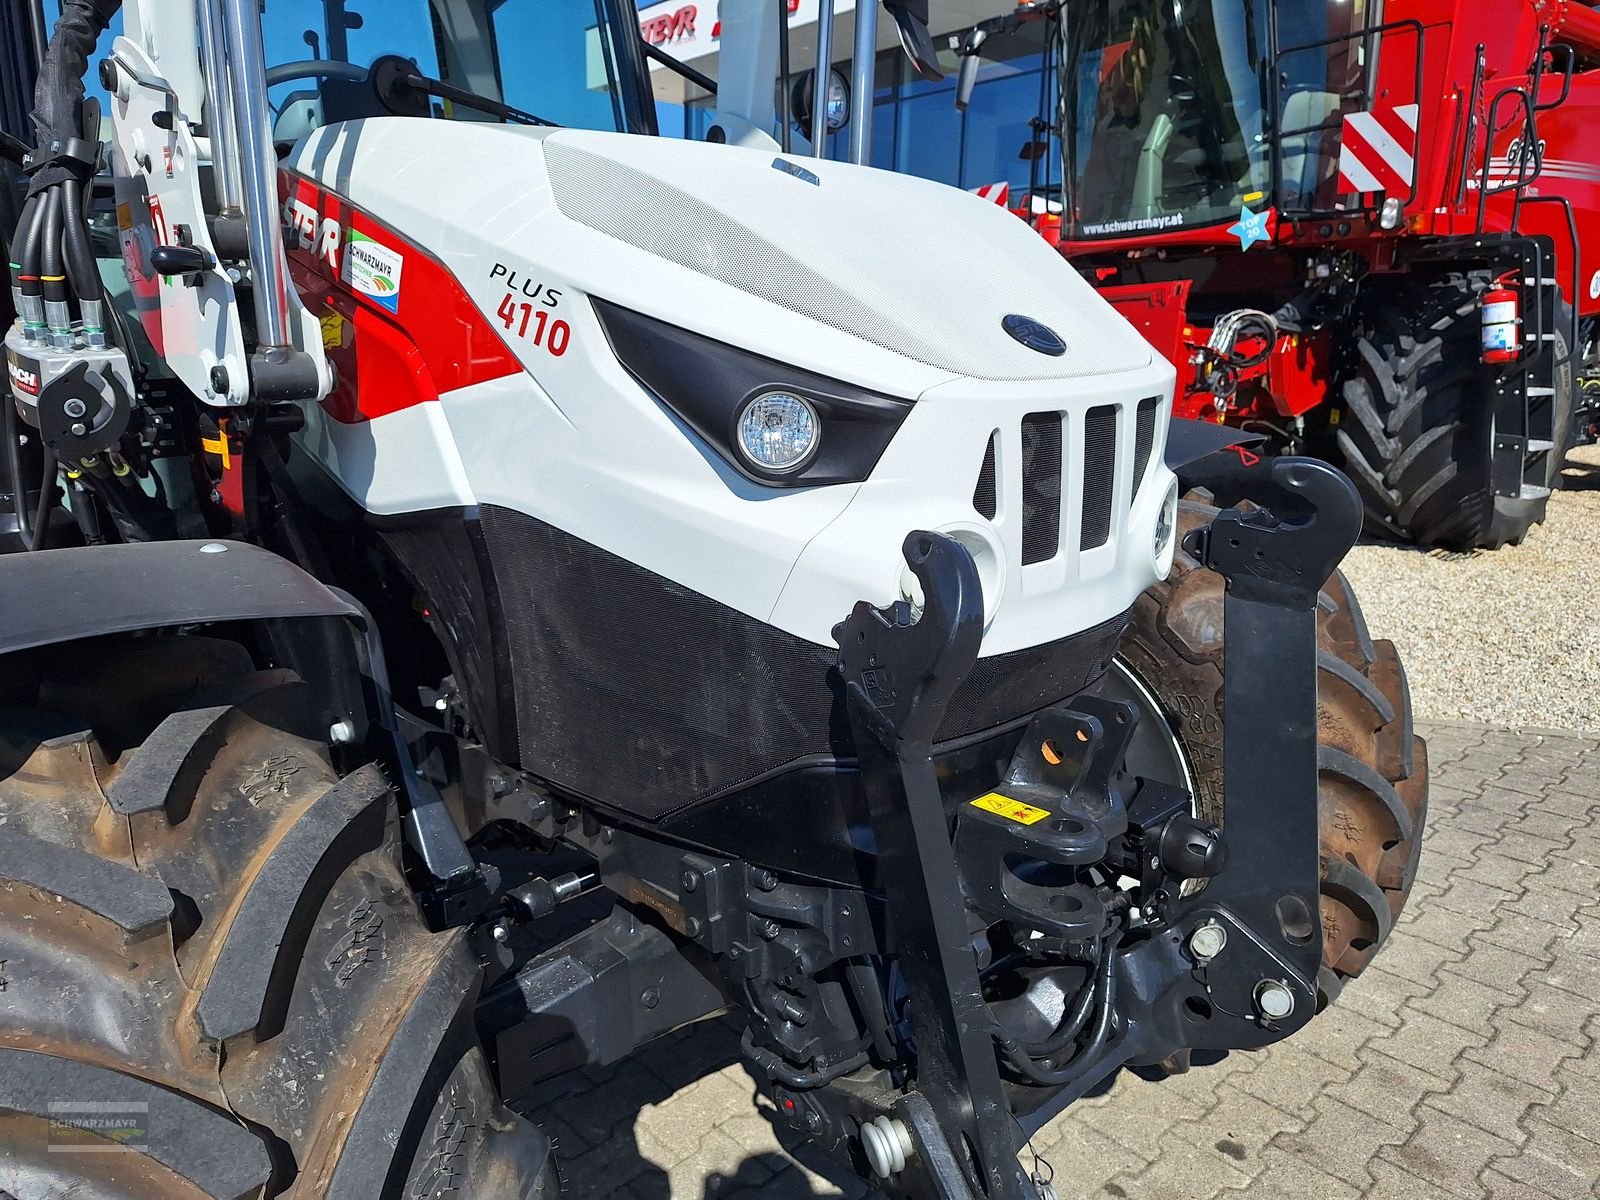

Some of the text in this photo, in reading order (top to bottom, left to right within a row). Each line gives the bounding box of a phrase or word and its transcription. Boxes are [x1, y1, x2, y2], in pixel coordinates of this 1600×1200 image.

[281, 196, 341, 269] STEYR
[1083, 211, 1184, 236] www.schwarzmayr.at
[1240, 215, 1261, 230] TOP
[1246, 227, 1260, 239] 20
[348, 243, 392, 277] SCHWARZMAYR
[489, 262, 563, 308] PLUS
[497, 292, 571, 357] 4110
